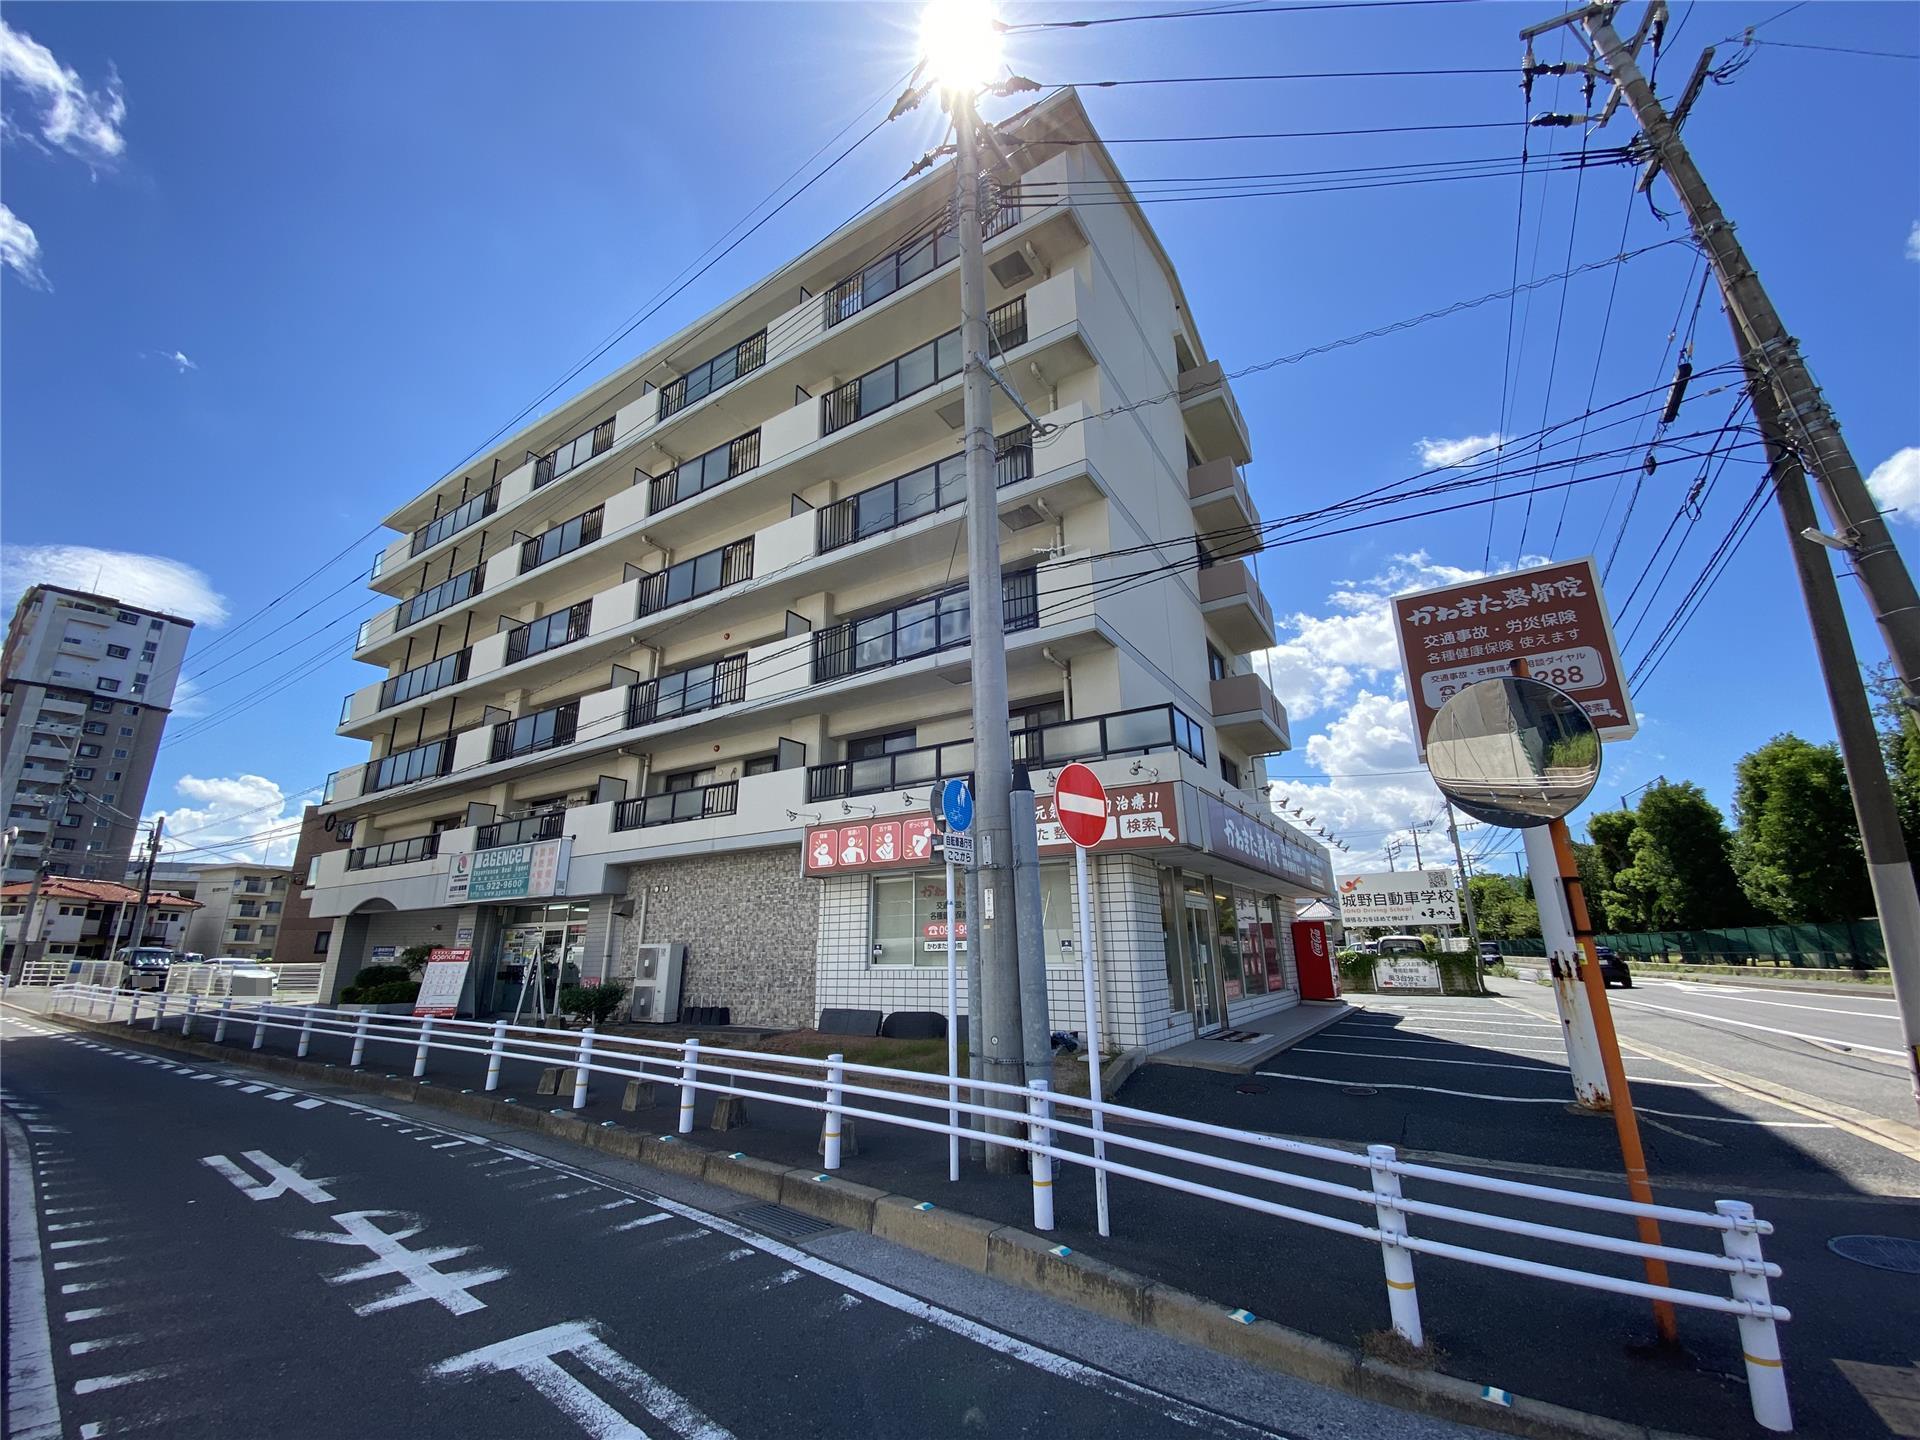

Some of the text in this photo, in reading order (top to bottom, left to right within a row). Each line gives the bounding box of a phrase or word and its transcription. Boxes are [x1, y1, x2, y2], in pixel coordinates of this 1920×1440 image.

[1406, 576, 1587, 626] かわまた整骨院
[1423, 609, 1578, 648] 交通事故・労災保険
[1427, 628, 1581, 664] 各種健康保険 使えます
[1127, 817, 1157, 833] 検索
[946, 835, 972, 849] 自転車通行可
[948, 850, 972, 862] ここから
[1342, 889, 1455, 907] 城野自動車学校
